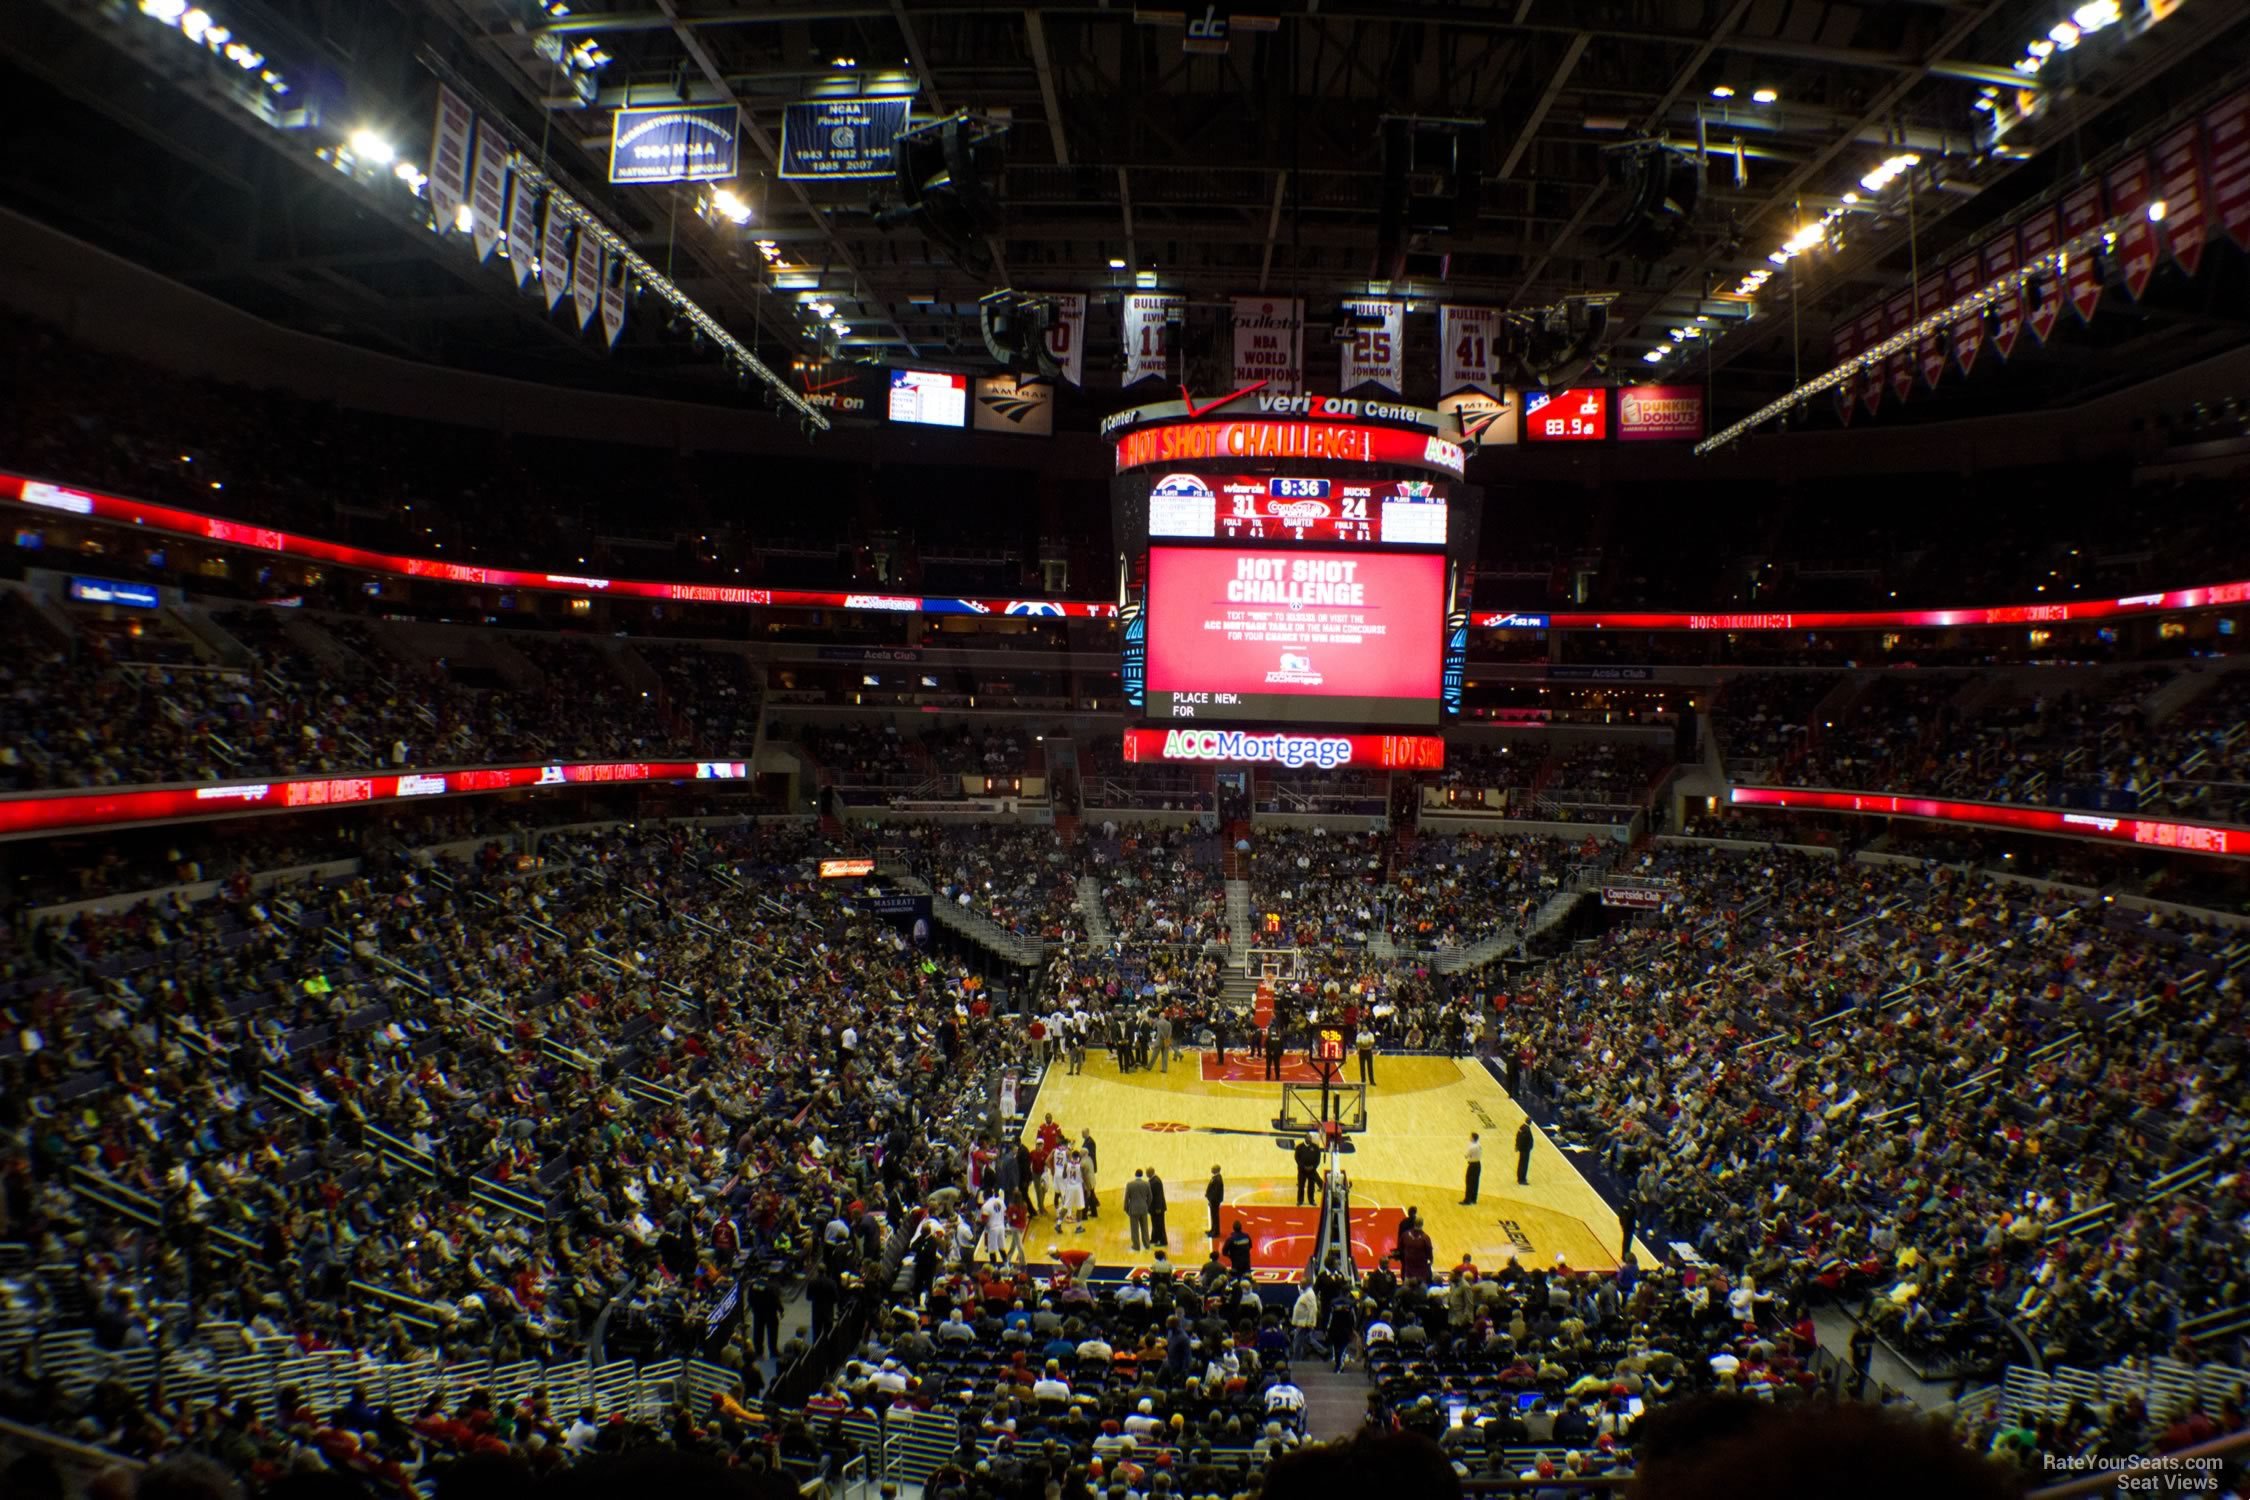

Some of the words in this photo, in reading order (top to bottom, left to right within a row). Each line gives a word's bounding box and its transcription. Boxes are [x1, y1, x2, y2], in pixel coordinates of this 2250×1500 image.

[829, 104, 861, 115] NCAA
[817, 116, 843, 126] Final
[847, 115, 872, 125] Four
[618, 164, 668, 177] NATIONAL
[1351, 304, 1393, 316] BULLETS
[1450, 308, 1492, 321] BULLETS
[1462, 324, 1479, 334] WES
[1141, 326, 1167, 355] 11
[1253, 336, 1277, 348] NBA
[1353, 333, 1392, 363] 25
[1455, 337, 1486, 368] 41
[1244, 352, 1286, 364] WORLD
[1352, 367, 1392, 377] JOHNSON
[1455, 371, 1486, 382] UNSELD
[991, 386, 1048, 398] AMTRAK
[803, 391, 864, 411] verizon
[1258, 392, 1357, 416] verizon
[1365, 401, 1422, 422] Center
[1107, 410, 1136, 429] Center
[1643, 412, 1697, 423] DONUTS
[1546, 419, 1582, 435] 83.9
[1128, 430, 1157, 466] HOT
[1162, 425, 1221, 458] SHOT
[1228, 423, 1376, 461] CHALLENGE!
[1281, 481, 1319, 496] 9:36
[1343, 487, 1371, 497] BUCKS
[1233, 495, 1257, 516] 31
[1342, 498, 1366, 519] 24
[1284, 518, 1314, 527] QUARTER
[1295, 527, 1303, 539] 2
[1237, 557, 1286, 581] HOT
[1292, 560, 1357, 583] SHOT
[1228, 580, 1364, 605] CHALLENGE
[1227, 611, 1245, 620] TEXT
[1350, 615, 1364, 623] THE
[1204, 621, 1221, 630] ACC
[1307, 624, 1321, 632] THE
[1228, 632, 1242, 640] FOR
[1244, 632, 1264, 641] YOUR
[894, 650, 917, 661] Club
[1623, 668, 1647, 679] Club
[1173, 692, 1208, 704] PLACE
[1215, 693, 1242, 705] NEW.
[1173, 705, 1194, 717] FOR
[1164, 730, 1351, 768] ACCMortgage
[1383, 736, 1418, 766] HOT
[1607, 889, 1643, 900] Courtside
[874, 898, 915, 907] MASERATI
[1321, 1030, 1341, 1041] 9:36
[1324, 1042, 1339, 1058] 17
